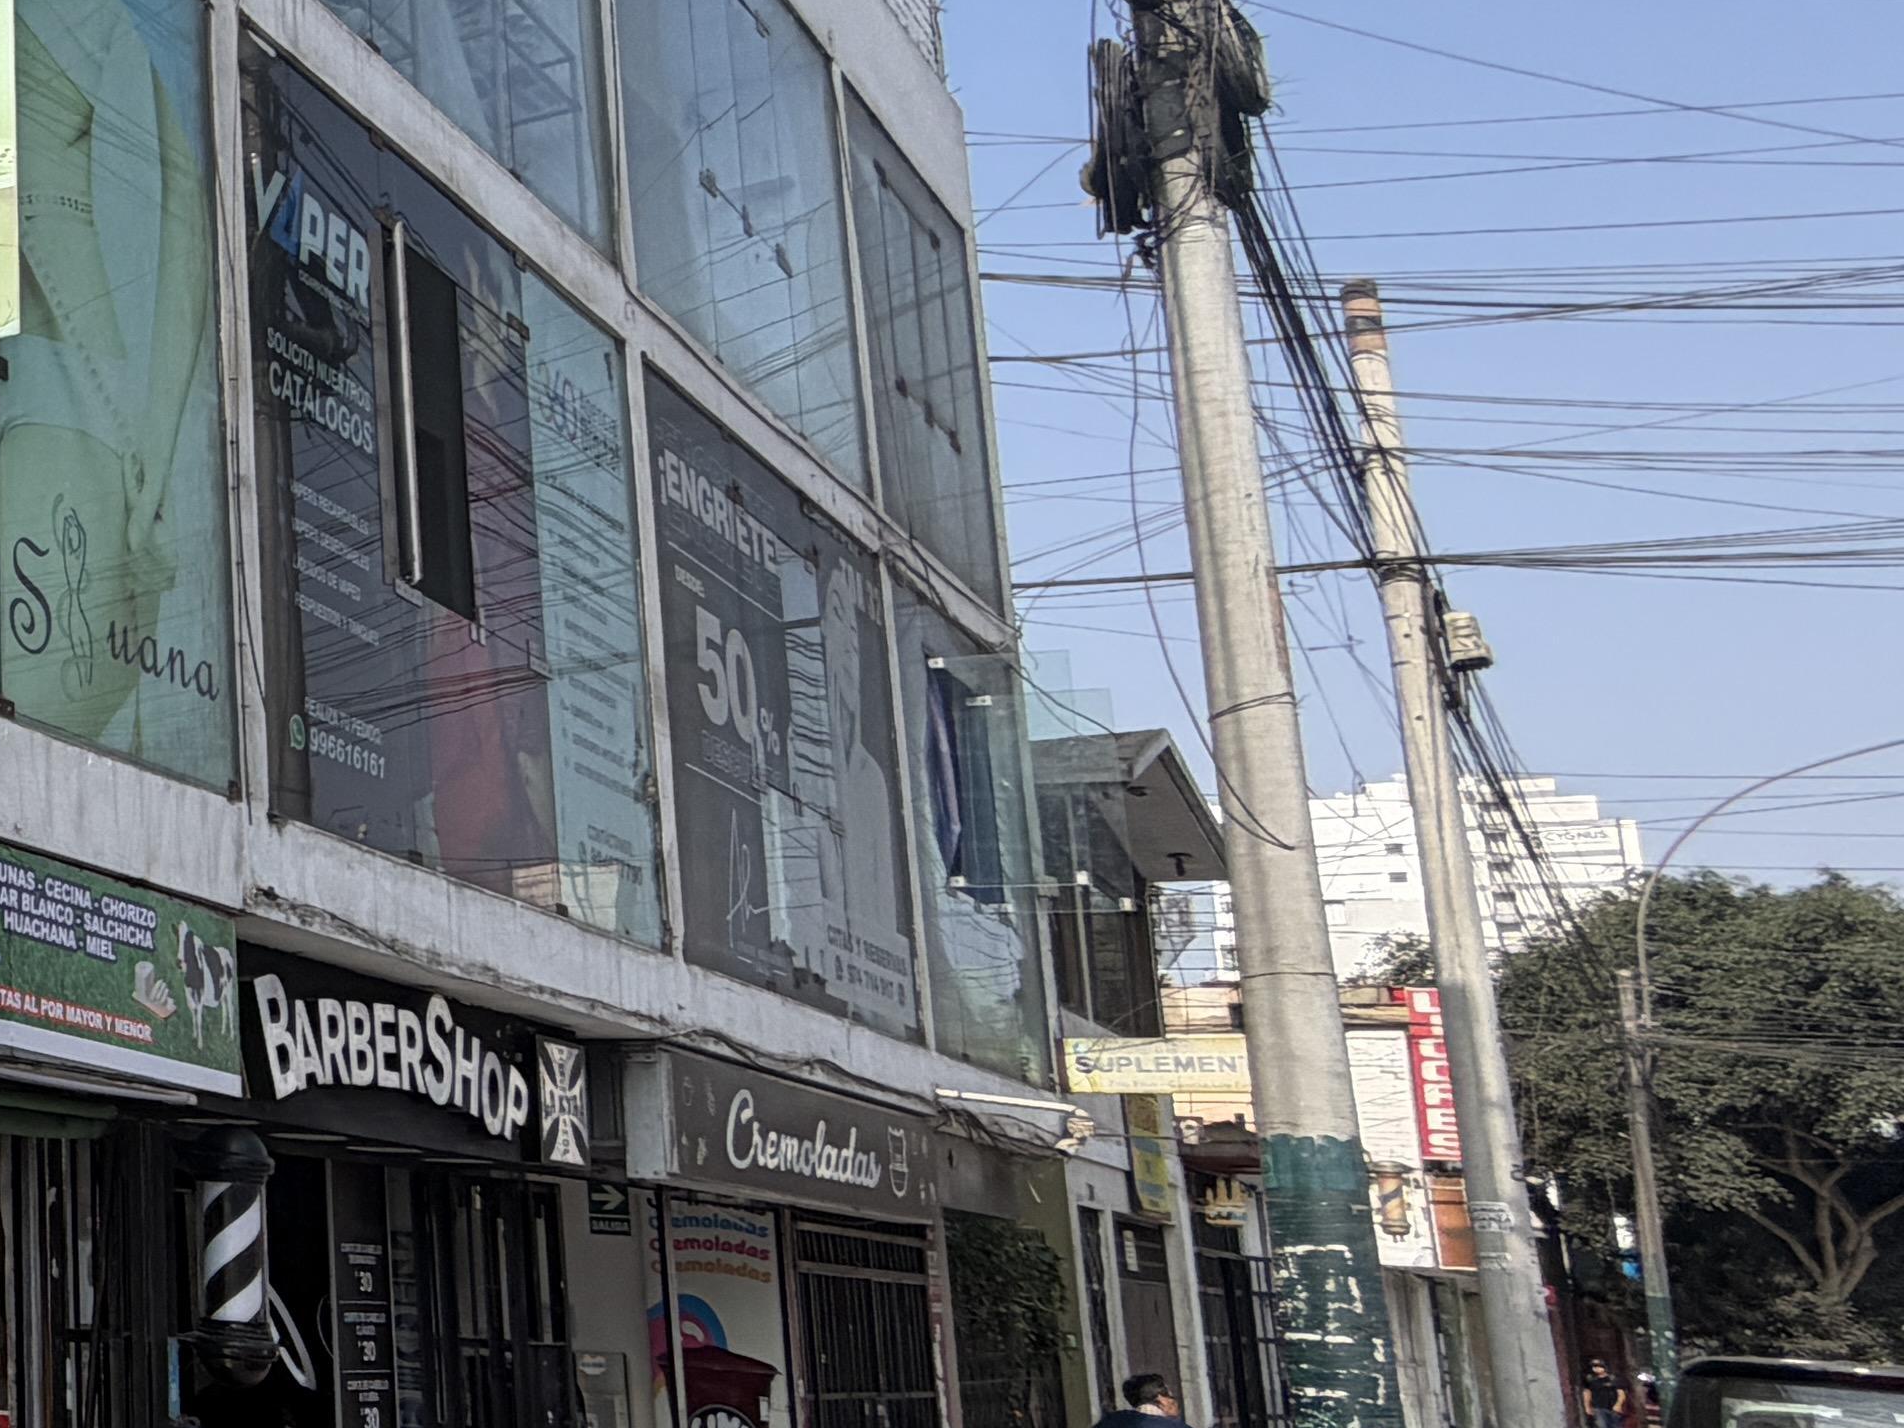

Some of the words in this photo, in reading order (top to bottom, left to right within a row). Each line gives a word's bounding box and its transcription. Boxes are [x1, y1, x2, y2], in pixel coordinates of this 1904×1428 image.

[269, 361, 374, 455] CATÁLOGOS
[45, 877, 93, 910] CECINA
[726, 1087, 882, 1190] Cremoladas
